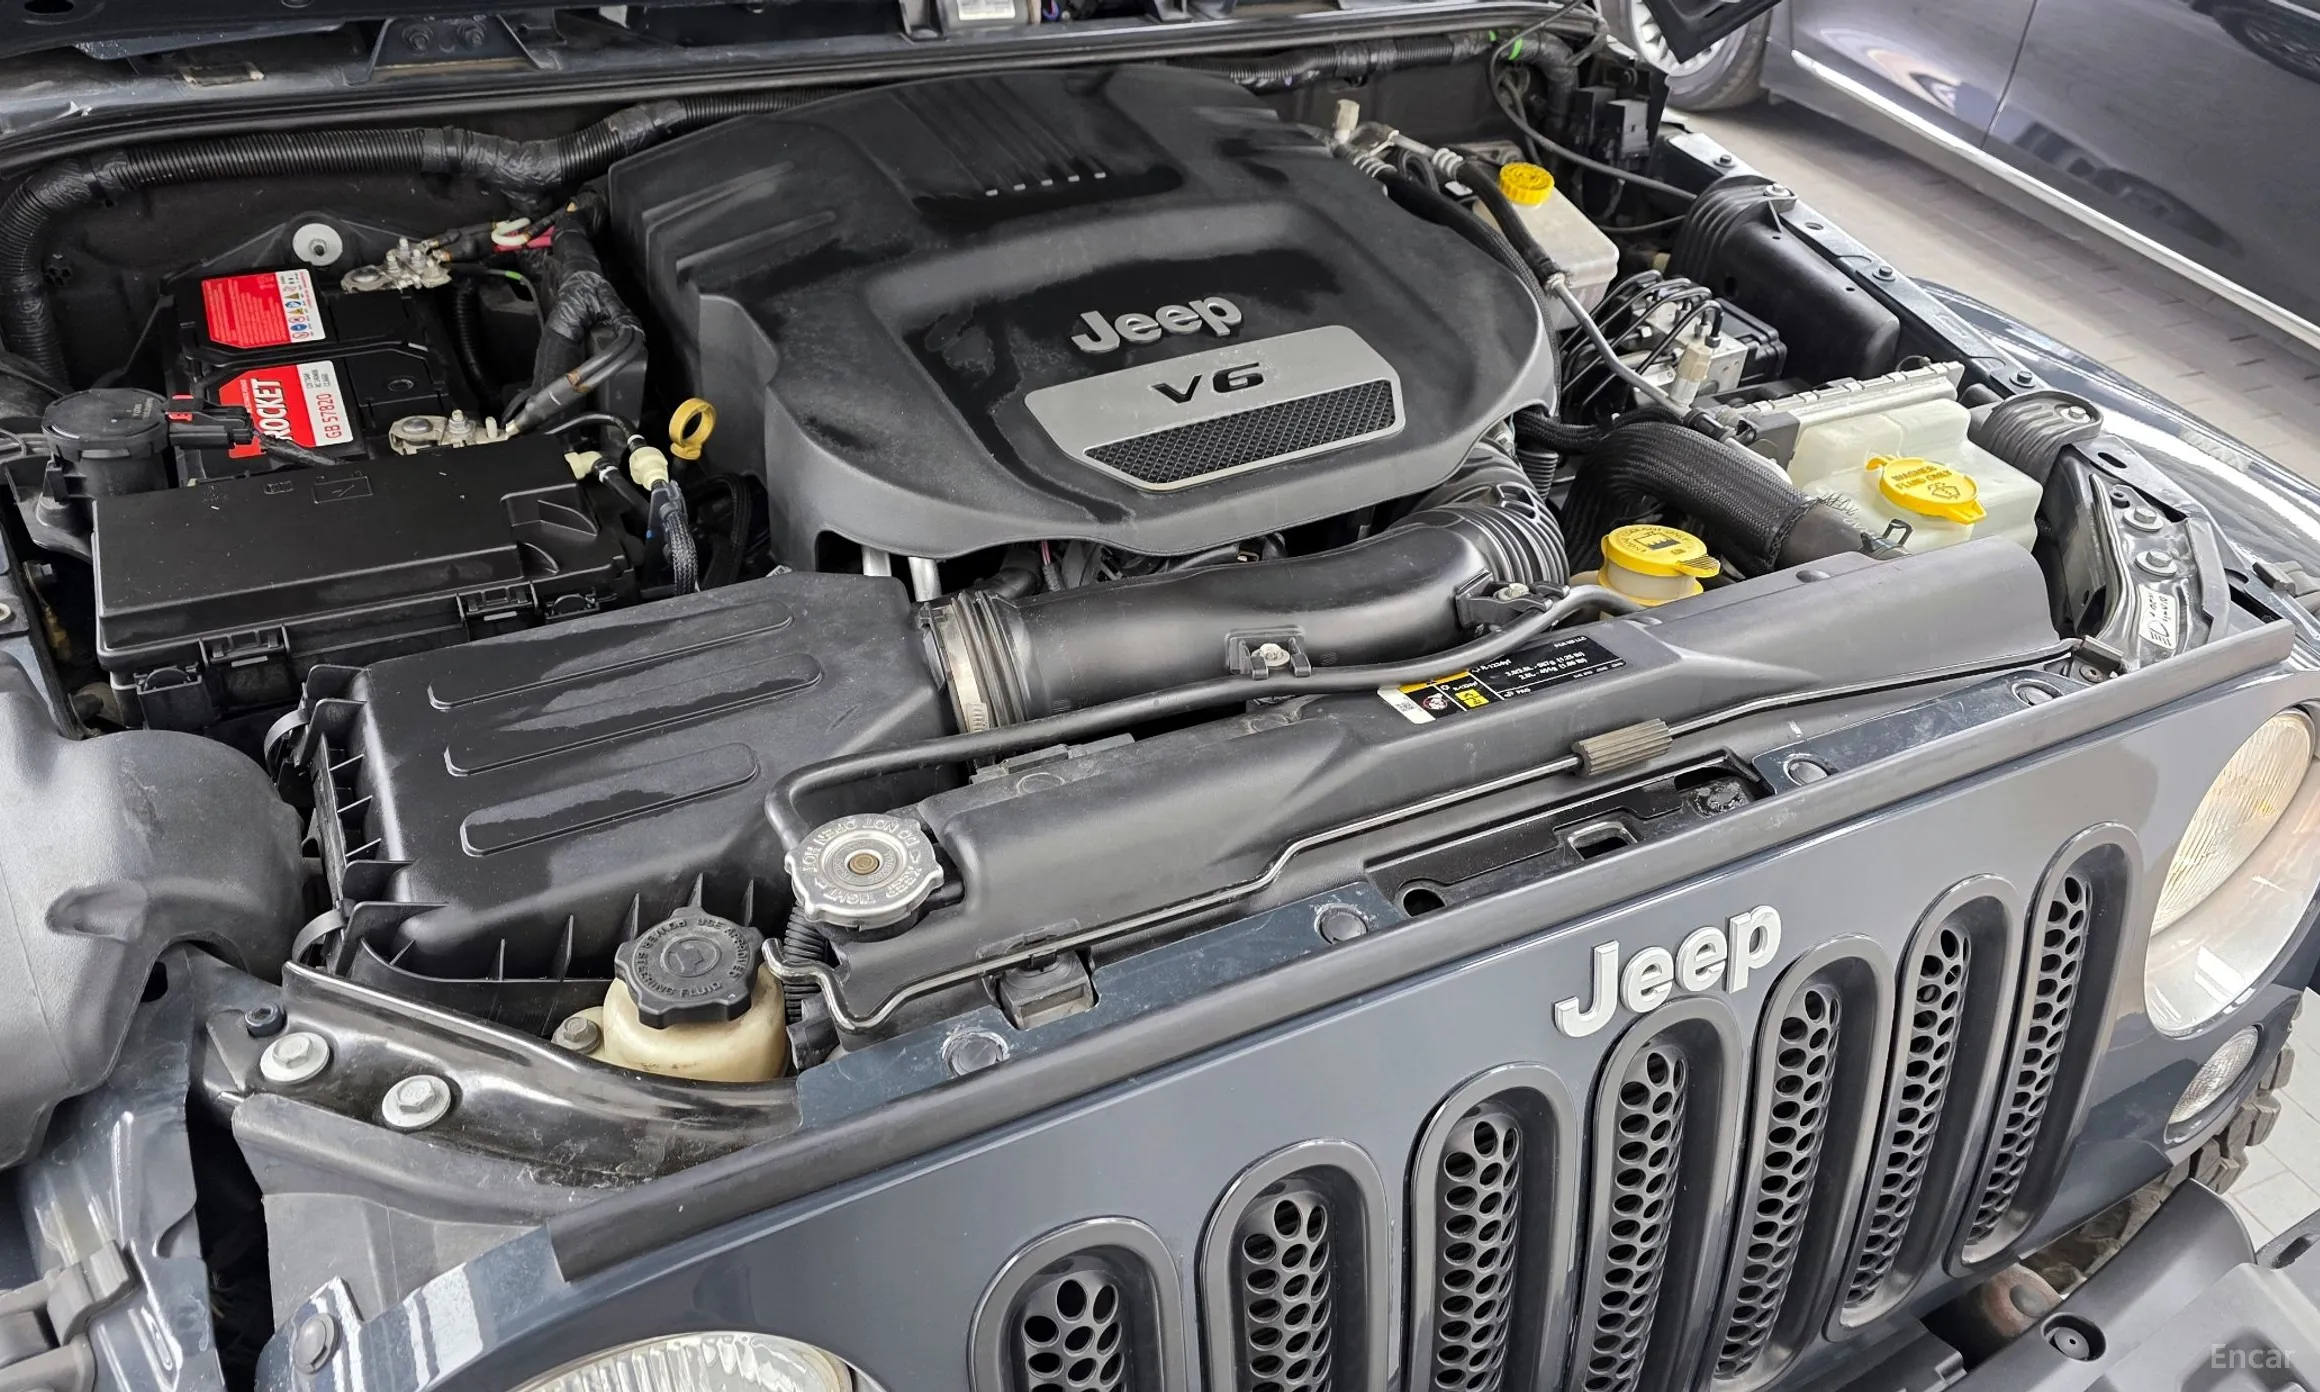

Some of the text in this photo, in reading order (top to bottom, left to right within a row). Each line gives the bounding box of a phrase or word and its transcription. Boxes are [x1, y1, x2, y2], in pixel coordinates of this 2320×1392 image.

[1071, 296, 1242, 353] Jeep
[1151, 362, 1264, 404] V6
[250, 378, 293, 441] ROCKET
[316, 393, 339, 423] 57820
[324, 424, 343, 439] GB
[813, 818, 858, 846] OPEN
[862, 818, 899, 834] NOT
[898, 829, 920, 847] DO
[802, 846, 822, 873] HOT
[823, 865, 922, 904] KEEP TIGHT
[698, 918, 725, 930] USE
[1553, 904, 1782, 1038] Jeep
[680, 981, 723, 998] FLUID
